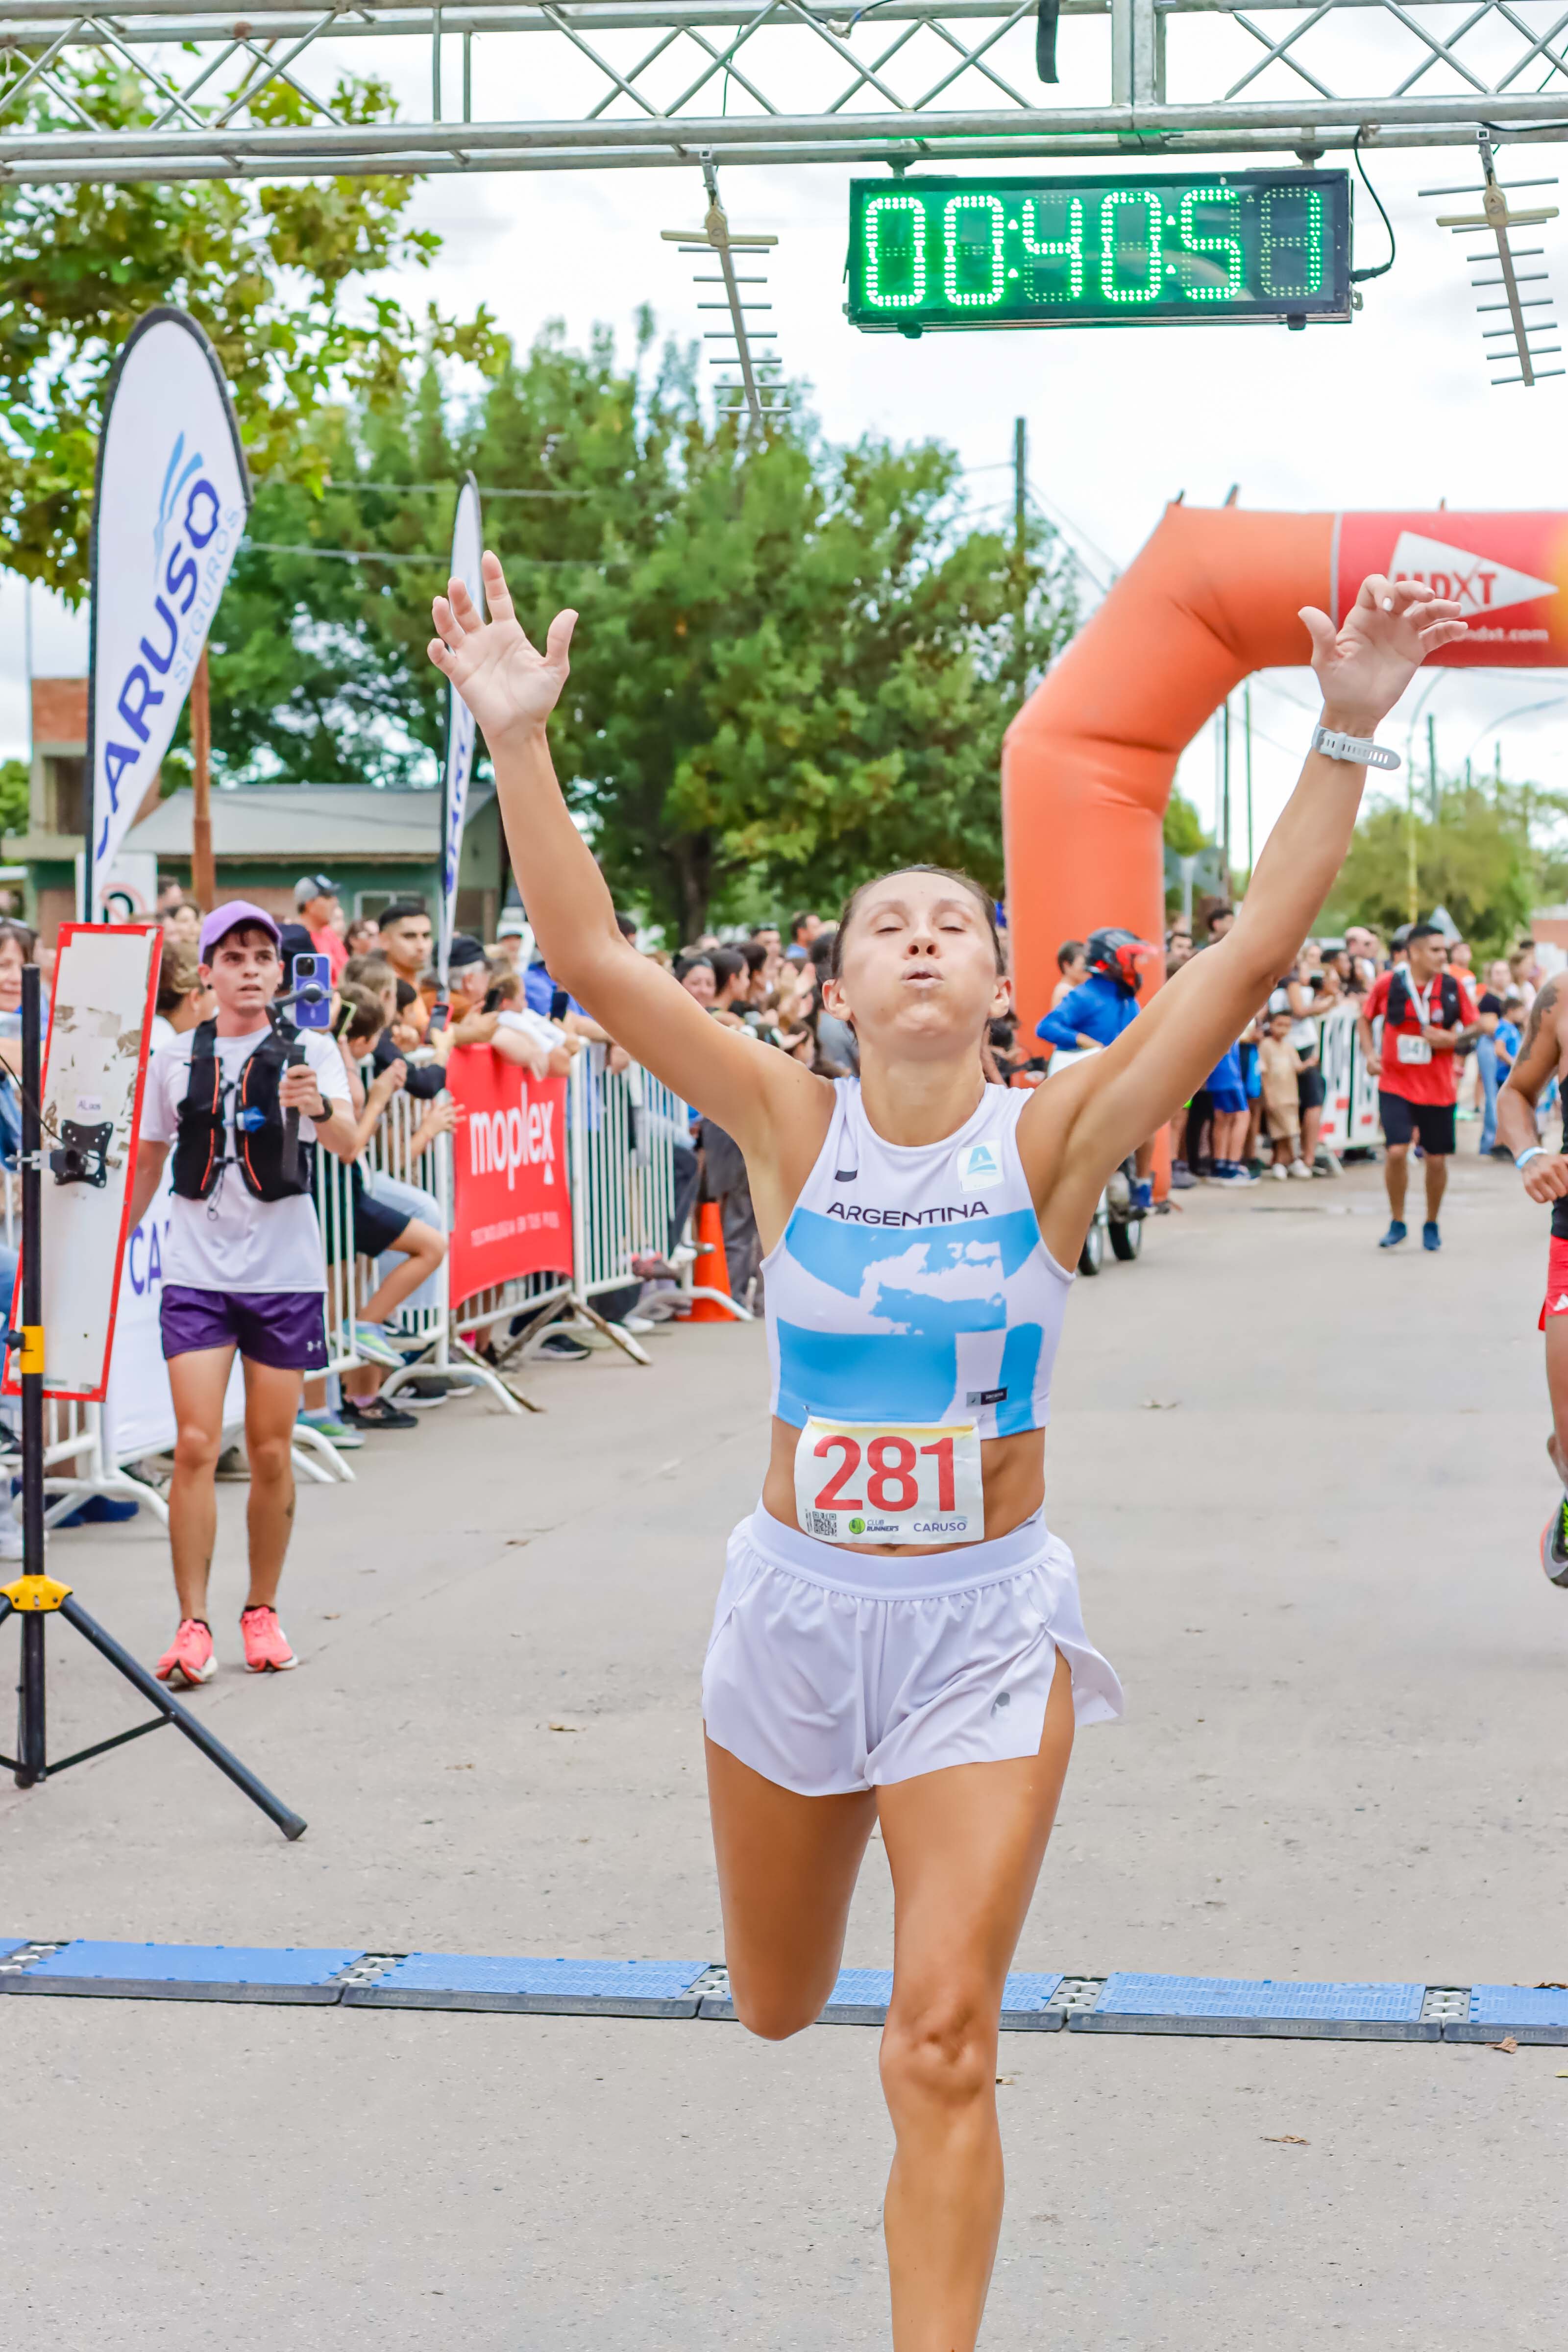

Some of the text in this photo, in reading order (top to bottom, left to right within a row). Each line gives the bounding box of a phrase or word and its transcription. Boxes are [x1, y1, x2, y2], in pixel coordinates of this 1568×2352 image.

[864, 188, 1322, 307] 00:40:51
[172, 507, 240, 687] SEGUROS
[469, 1080, 555, 1191] moplex
[826, 1201, 990, 1227] ARGENTINA
[129, 1220, 170, 1295] CA
[813, 1435, 956, 1512] 281
[913, 1522, 966, 1532] CARUSO
